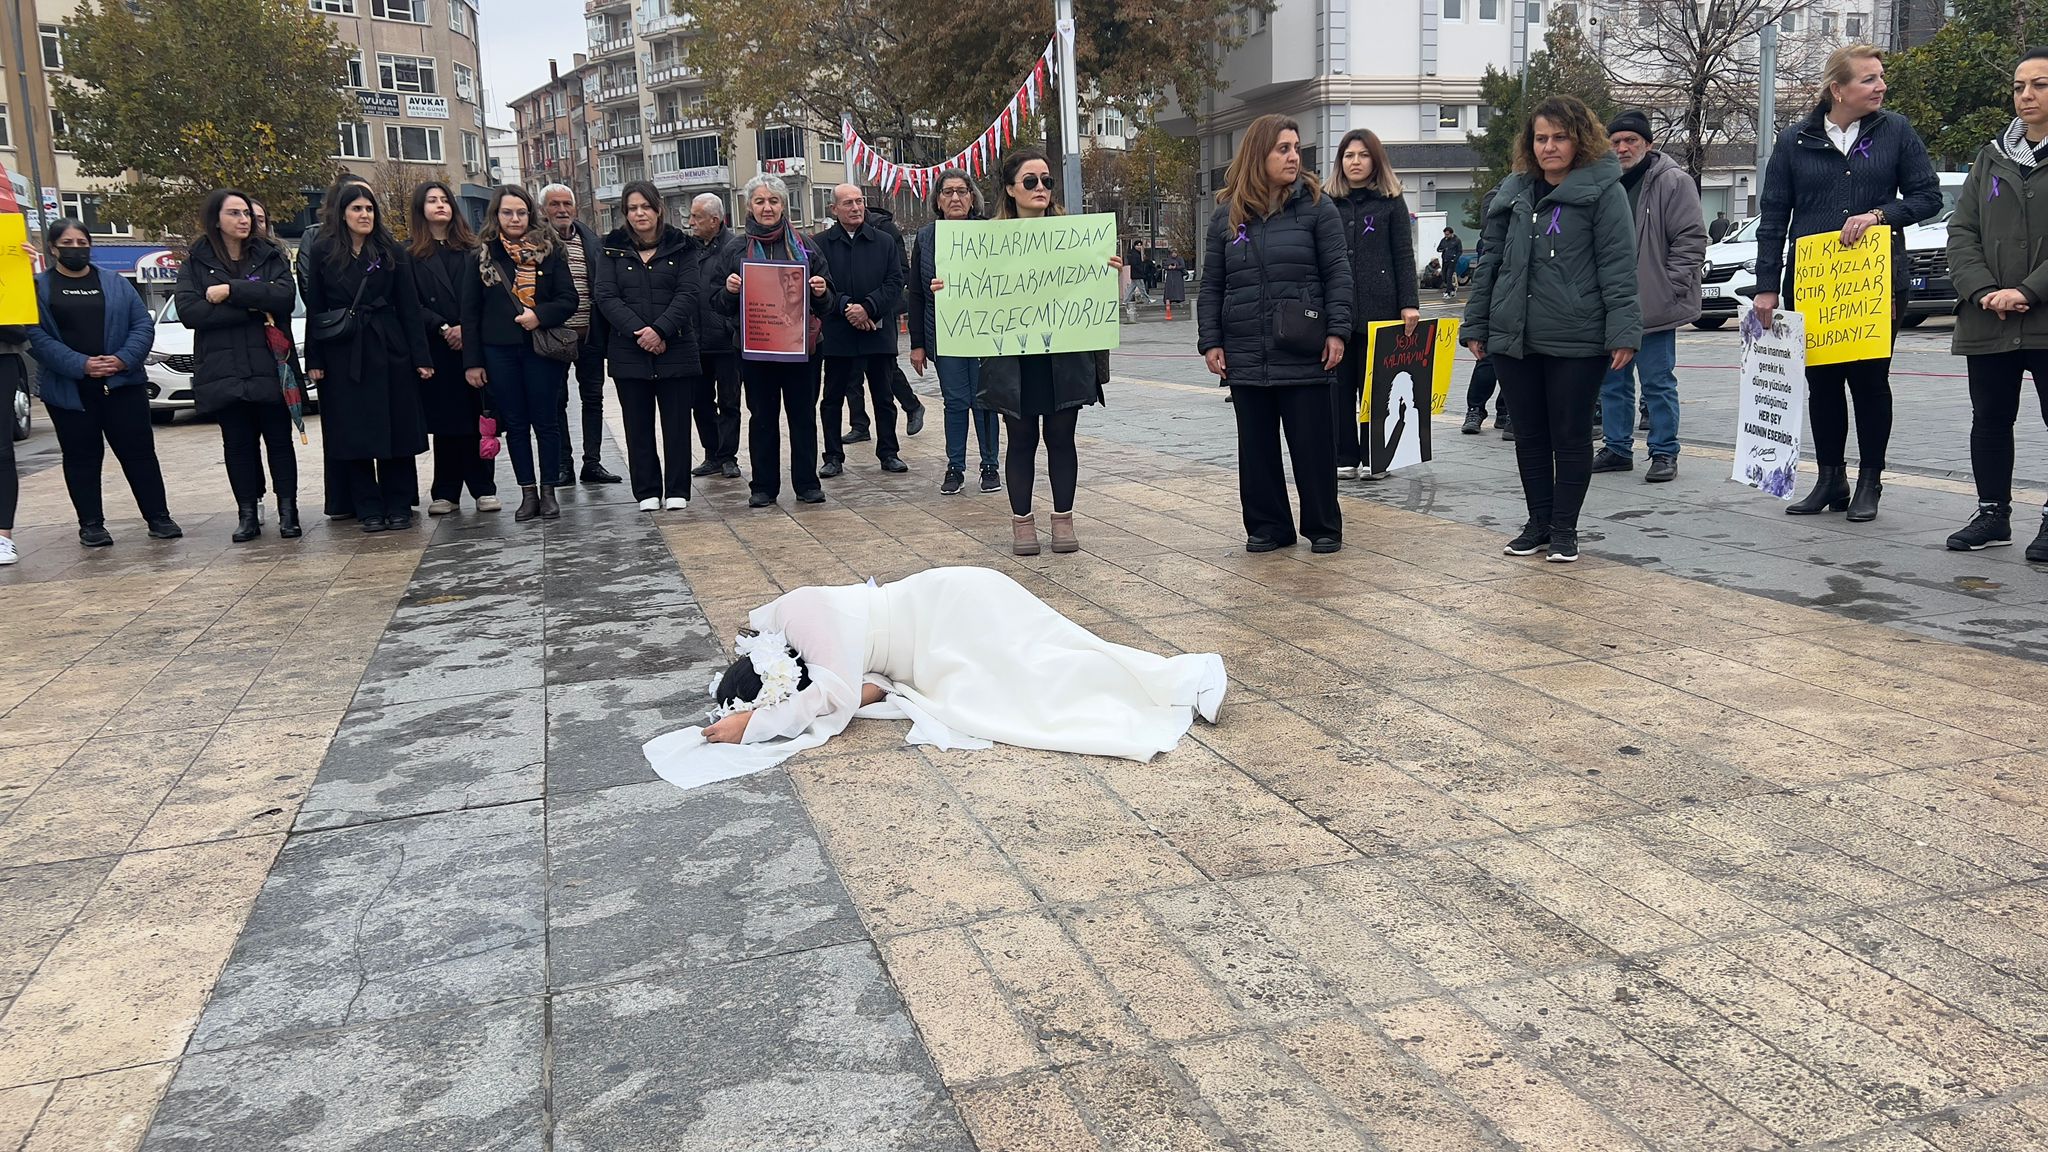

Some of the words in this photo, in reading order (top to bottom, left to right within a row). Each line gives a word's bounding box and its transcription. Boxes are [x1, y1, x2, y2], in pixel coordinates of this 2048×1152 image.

[358, 96, 398, 107] AVUKAT
[409, 97, 445, 106] AVUKAT
[949, 222, 1113, 261] HAKLARIMIZDAN
[1795, 262, 1825, 283] KÖTÜ
[1830, 254, 1885, 280] KIZLAR
[948, 264, 1110, 299] HAYATLARIMIZDAN
[1795, 283, 1826, 303] ÇITIR
[1832, 274, 1884, 302] KIZLAR
[1708, 288, 1718, 296] 125
[939, 298, 1118, 339] VAZGEÇMİYORUZ
[1819, 296, 1882, 325] HEPİMİZ
[1805, 323, 1881, 350] BURDAYIZ
[1753, 342, 1767, 356] Şuna
[1768, 344, 1791, 360] inanmak
[1758, 361, 1777, 374] gerekir
[1752, 376, 1768, 391] dünya
[1768, 378, 1792, 394] yüzünde
[1754, 393, 1788, 411] gördüğümüz
[1758, 409, 1770, 422] HER
[1770, 412, 1782, 427] ŞEY
[1744, 422, 1767, 440] KADININ
